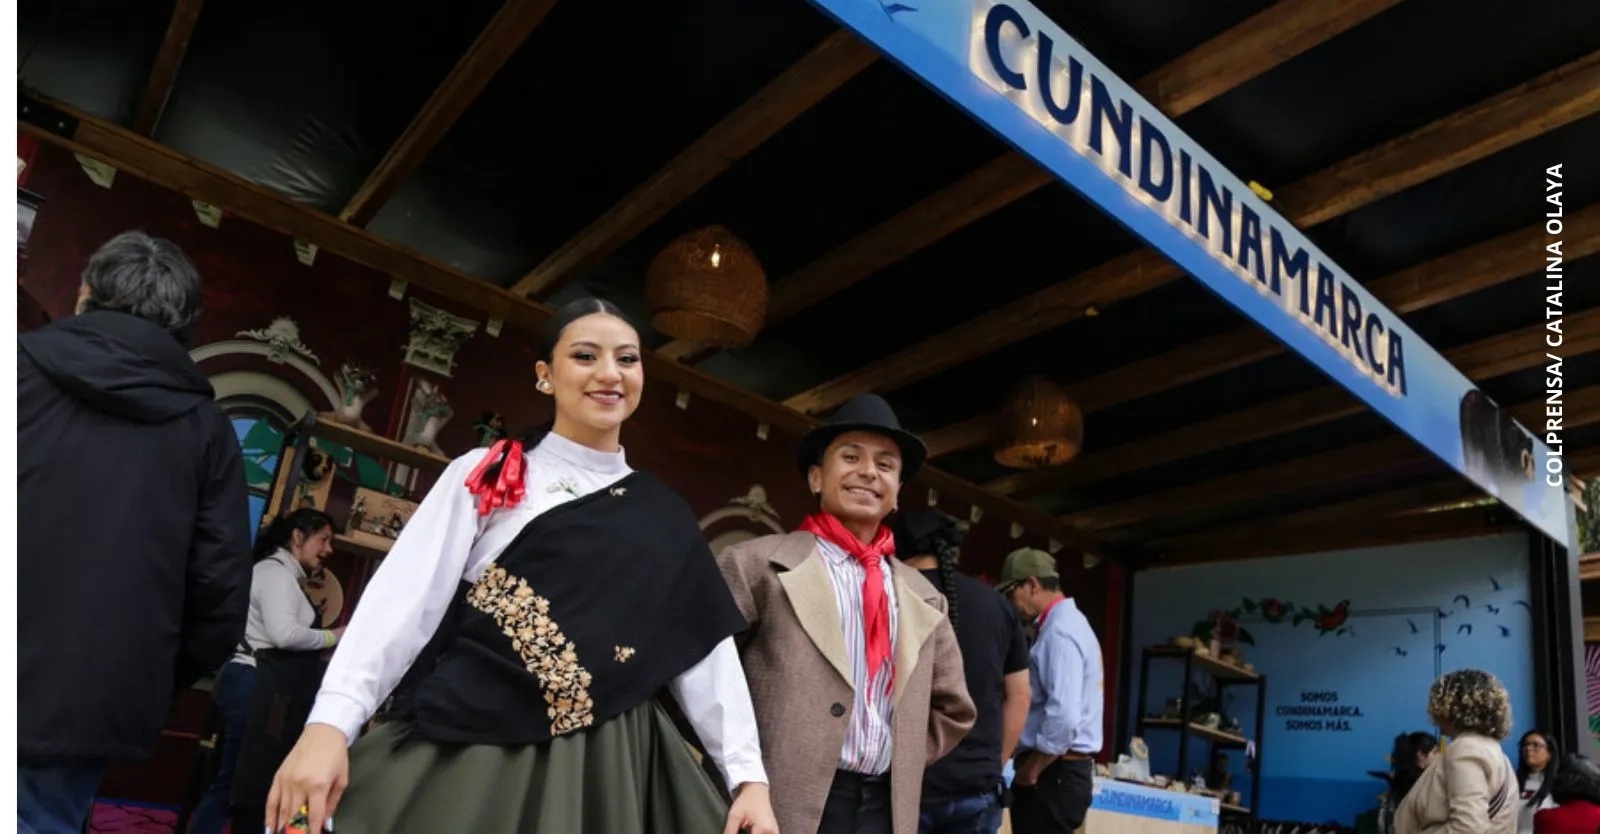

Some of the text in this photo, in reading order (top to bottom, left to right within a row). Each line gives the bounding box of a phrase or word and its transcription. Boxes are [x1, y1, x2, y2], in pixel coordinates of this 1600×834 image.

[985, 3, 1407, 396] CUNDINAMARCA
[1301, 691, 1338, 702] SOMOS
[1286, 720, 1322, 731] SOMOS
